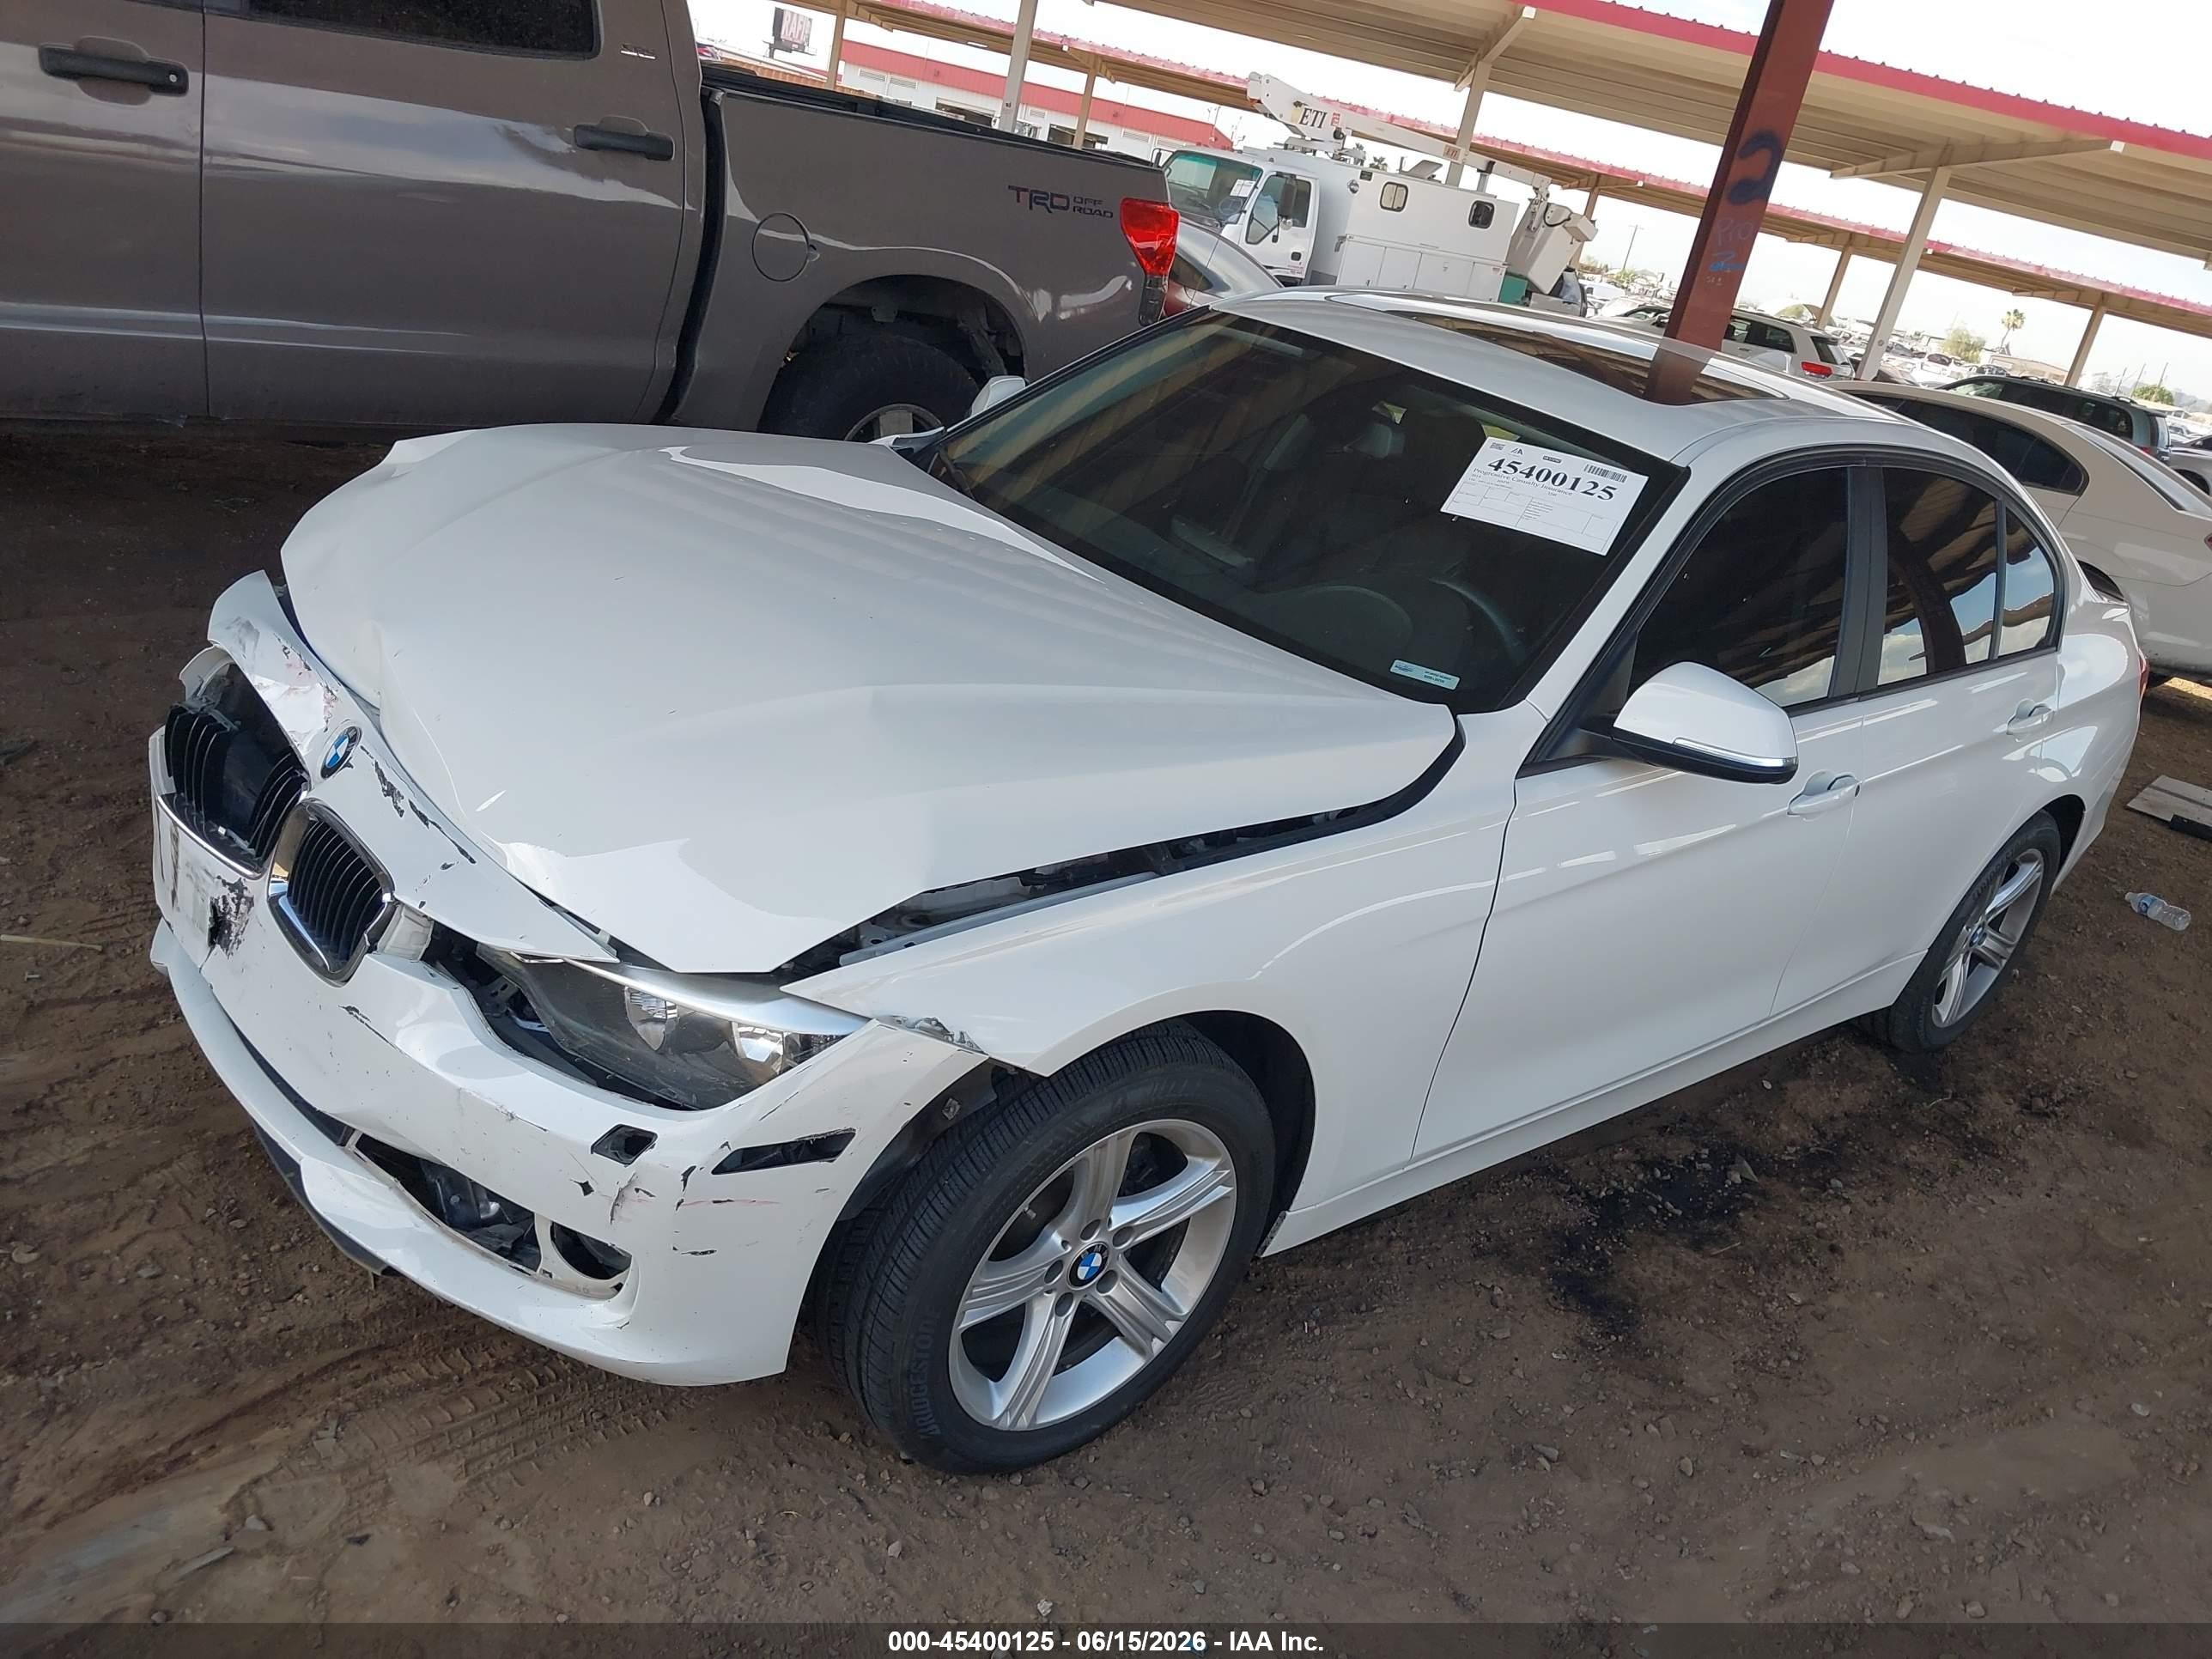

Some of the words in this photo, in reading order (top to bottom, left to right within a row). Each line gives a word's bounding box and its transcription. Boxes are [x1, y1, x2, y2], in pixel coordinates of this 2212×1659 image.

[1299, 107, 1328, 129] ETI
[1007, 185, 1070, 214] TRD
[1073, 196, 1104, 206] OFF
[1073, 206, 1114, 219] ROAD
[1473, 467, 1510, 481] Progressive
[1511, 476, 1540, 488] Casualty
[1540, 483, 1573, 495] Insurance
[1487, 457, 1618, 501] 45400125
